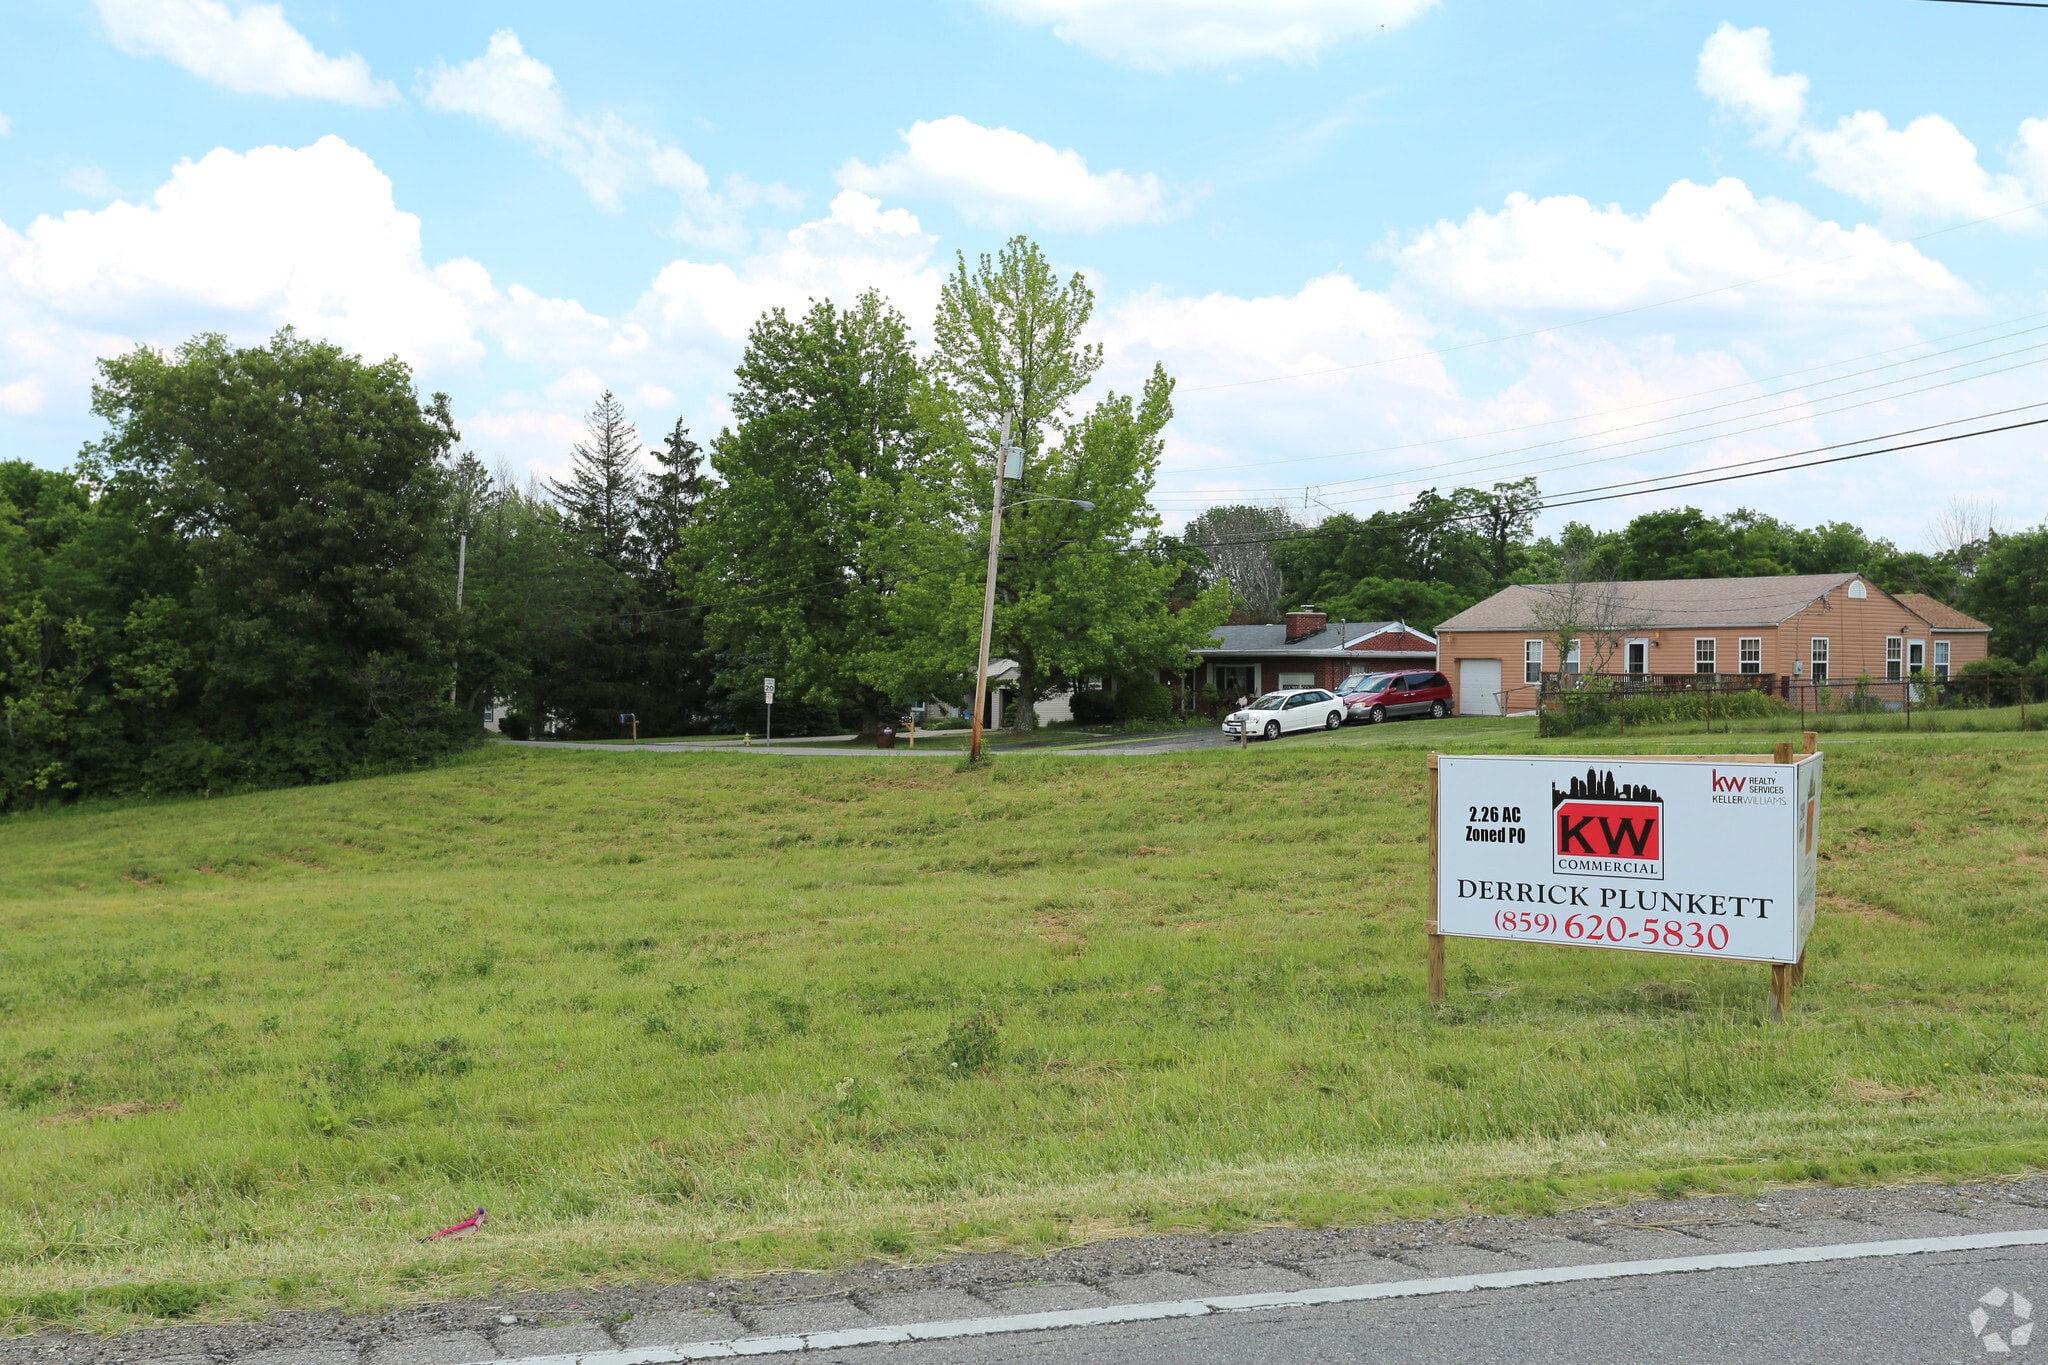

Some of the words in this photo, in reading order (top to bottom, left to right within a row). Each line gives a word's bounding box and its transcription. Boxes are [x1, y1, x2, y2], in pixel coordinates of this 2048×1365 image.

[1749, 776, 1776, 785] REALTY
[1749, 785, 1784, 794] SERVICES
[1469, 806, 1499, 823] 2.26
[1502, 807, 1521, 823] AC
[1465, 825, 1506, 843] Zoned
[1508, 826, 1526, 844] PO
[1560, 815, 1656, 856] KW
[1558, 859, 1657, 874] COMMERCIAL
[1458, 879, 1589, 906] DERRICK
[1601, 887, 1774, 919] PLUNKETT
[1494, 908, 1557, 936] (859)
[1565, 914, 1729, 950] 620-5830
